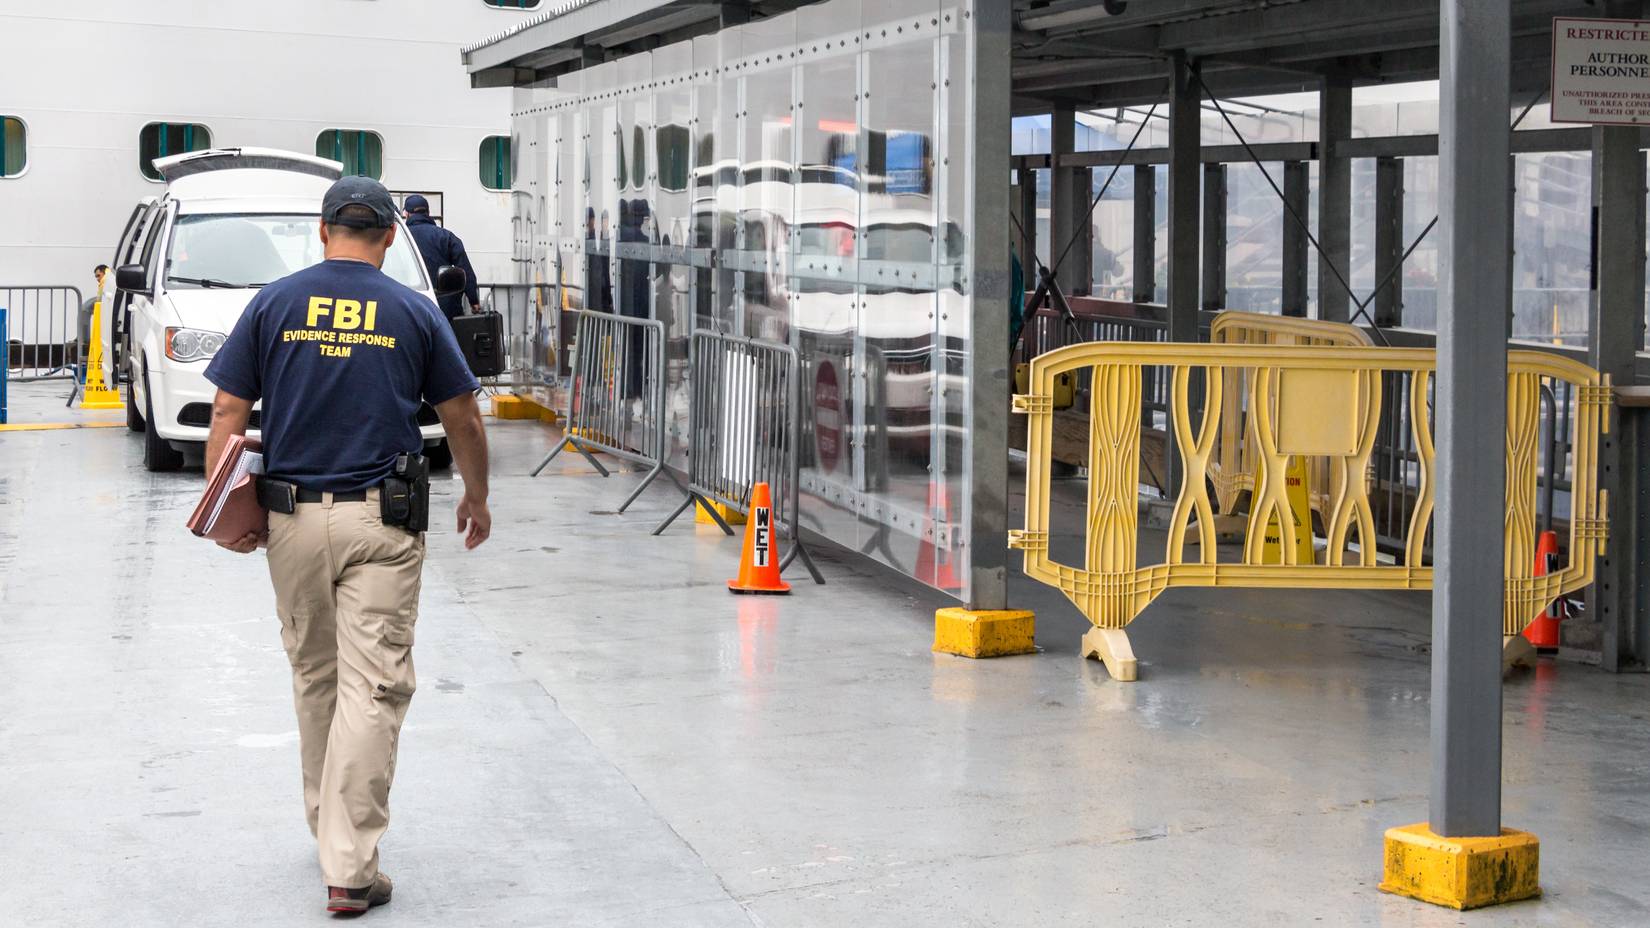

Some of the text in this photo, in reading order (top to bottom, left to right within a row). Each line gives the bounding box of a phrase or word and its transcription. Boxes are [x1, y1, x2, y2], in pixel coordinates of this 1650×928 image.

[1567, 28, 1649, 41] RESTRICTE
[1588, 52, 1649, 65] AUTHOR
[1571, 65, 1649, 78] PERSONNE
[1562, 90, 1629, 99] UNAUTHORIZED
[1579, 99, 1598, 107] THIS
[1600, 100, 1623, 108] AREA
[1589, 107, 1623, 116] BREACH
[306, 296, 377, 331] FBI
[283, 329, 396, 349] EVIDENCE RESPONSE
[320, 344, 351, 358] TEAM
[755, 508, 769, 566] WET
[1265, 535, 1280, 545] Wet
